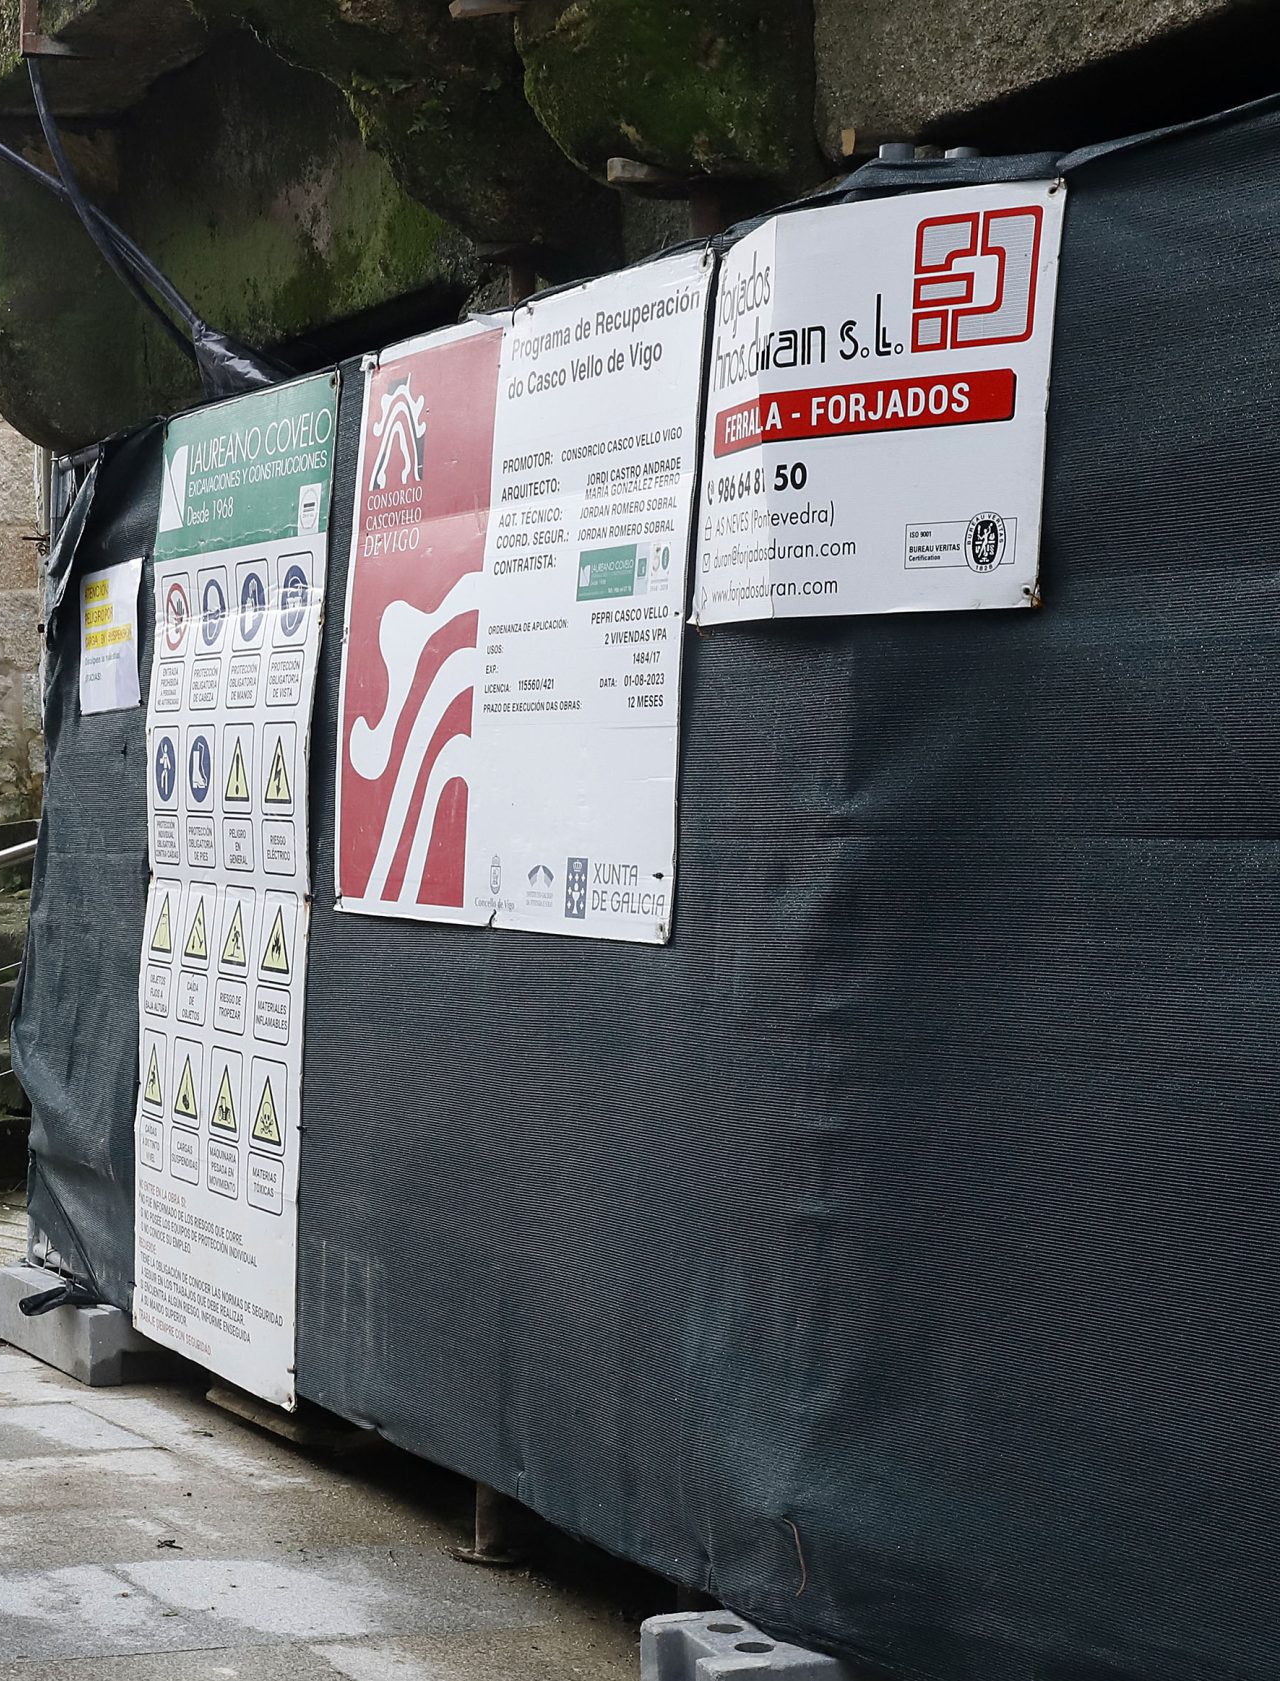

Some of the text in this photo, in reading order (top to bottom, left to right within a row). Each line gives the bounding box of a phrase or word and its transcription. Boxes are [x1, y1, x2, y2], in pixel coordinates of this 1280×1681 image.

[718, 251, 771, 339] forjados
[512, 286, 701, 361] Programa de Recuperación
[508, 341, 663, 400] do Casco Vello de Vigo
[811, 382, 971, 427] FORJADOS
[190, 408, 332, 475] LAUREANO COVELO
[502, 426, 683, 474] PROMOTOR: CONSORCIO CASCO VELLO VIGO
[188, 450, 328, 497] EXCAVACIONES Y CONSTRUCCIONES
[501, 456, 682, 502] ARQUITECTO: JORDI CASTRO ANDRADE
[718, 474, 736, 503] 986
[738, 471, 751, 499] 64
[773, 461, 808, 491] 50
[584, 472, 681, 501] MARÍA GONZÁLEZ FERRO
[367, 486, 423, 511] CONSORCIO
[187, 496, 234, 527] Desde 1968
[520, 506, 563, 525] TÉCNICO:
[579, 504, 610, 520] JORDAN
[611, 499, 645, 516] ROMERO
[646, 495, 678, 512] SOBRAL
[726, 511, 749, 535] NEVES
[751, 500, 835, 534] (Pontevedra)
[496, 519, 675, 551] COORD. SEGUR.: JORDAN ROMERO SOBRAL
[909, 543, 961, 553] BUREAU VERITAS
[493, 554, 557, 576] CONTRATISTA:
[711, 575, 838, 606] www.forjadosduran.com
[488, 605, 669, 636] ORDENANZA DE APLICACIÓN: PEPRI CASCO VELLO
[486, 628, 667, 655] USOS: 2 VIVENDAS VPA
[271, 660, 300, 671] PROTECCIÓN
[485, 651, 661, 675] EXP.: 1484/17
[192, 680, 217, 690] OBLIGATORIA
[229, 677, 256, 688] OBLIGATORIA
[269, 674, 299, 685] OBLIGATORIA
[484, 683, 512, 694] LICENCIA:
[599, 678, 618, 689] DATA:
[624, 672, 665, 687] 01-08-2023
[272, 687, 293, 698] DE VISTA
[483, 694, 664, 714] PRAZO DE EXECUCIÓN DAS OBRAS: 12 MESES
[188, 838, 213, 849] OBLIGATORIA
[229, 829, 246, 840] PELIGRO
[270, 835, 287, 846] RIESGO
[235, 842, 241, 852] EN
[267, 848, 291, 861] ELÉCTRICO
[229, 854, 248, 865] GENERAL
[593, 862, 638, 886] XUNTA
[591, 890, 665, 916] DE GALICIA
[189, 996, 195, 1006] DE
[220, 992, 242, 1006] RIESGO DE
[257, 1001, 287, 1016] MATERIALES
[182, 1008, 200, 1021] OBJETOS
[219, 1007, 241, 1020] TROPEZAR
[256, 1015, 288, 1031] INFLAMABLES
[176, 1141, 193, 1155] CARGAS
[209, 1147, 237, 1164] MAQUINARIA
[171, 1152, 198, 1170] SUSPENDIDAS
[228, 1166, 234, 1177] EN
[252, 1167, 277, 1184] MATERIAS
[209, 1176, 236, 1193] MOVIMIENTO
[253, 1181, 275, 1198] TÓXICAS
[244, 1300, 251, 1313] DE
[252, 1304, 284, 1327] SEGURIDAD
[223, 1320, 251, 1344] ENSEGUIDA
